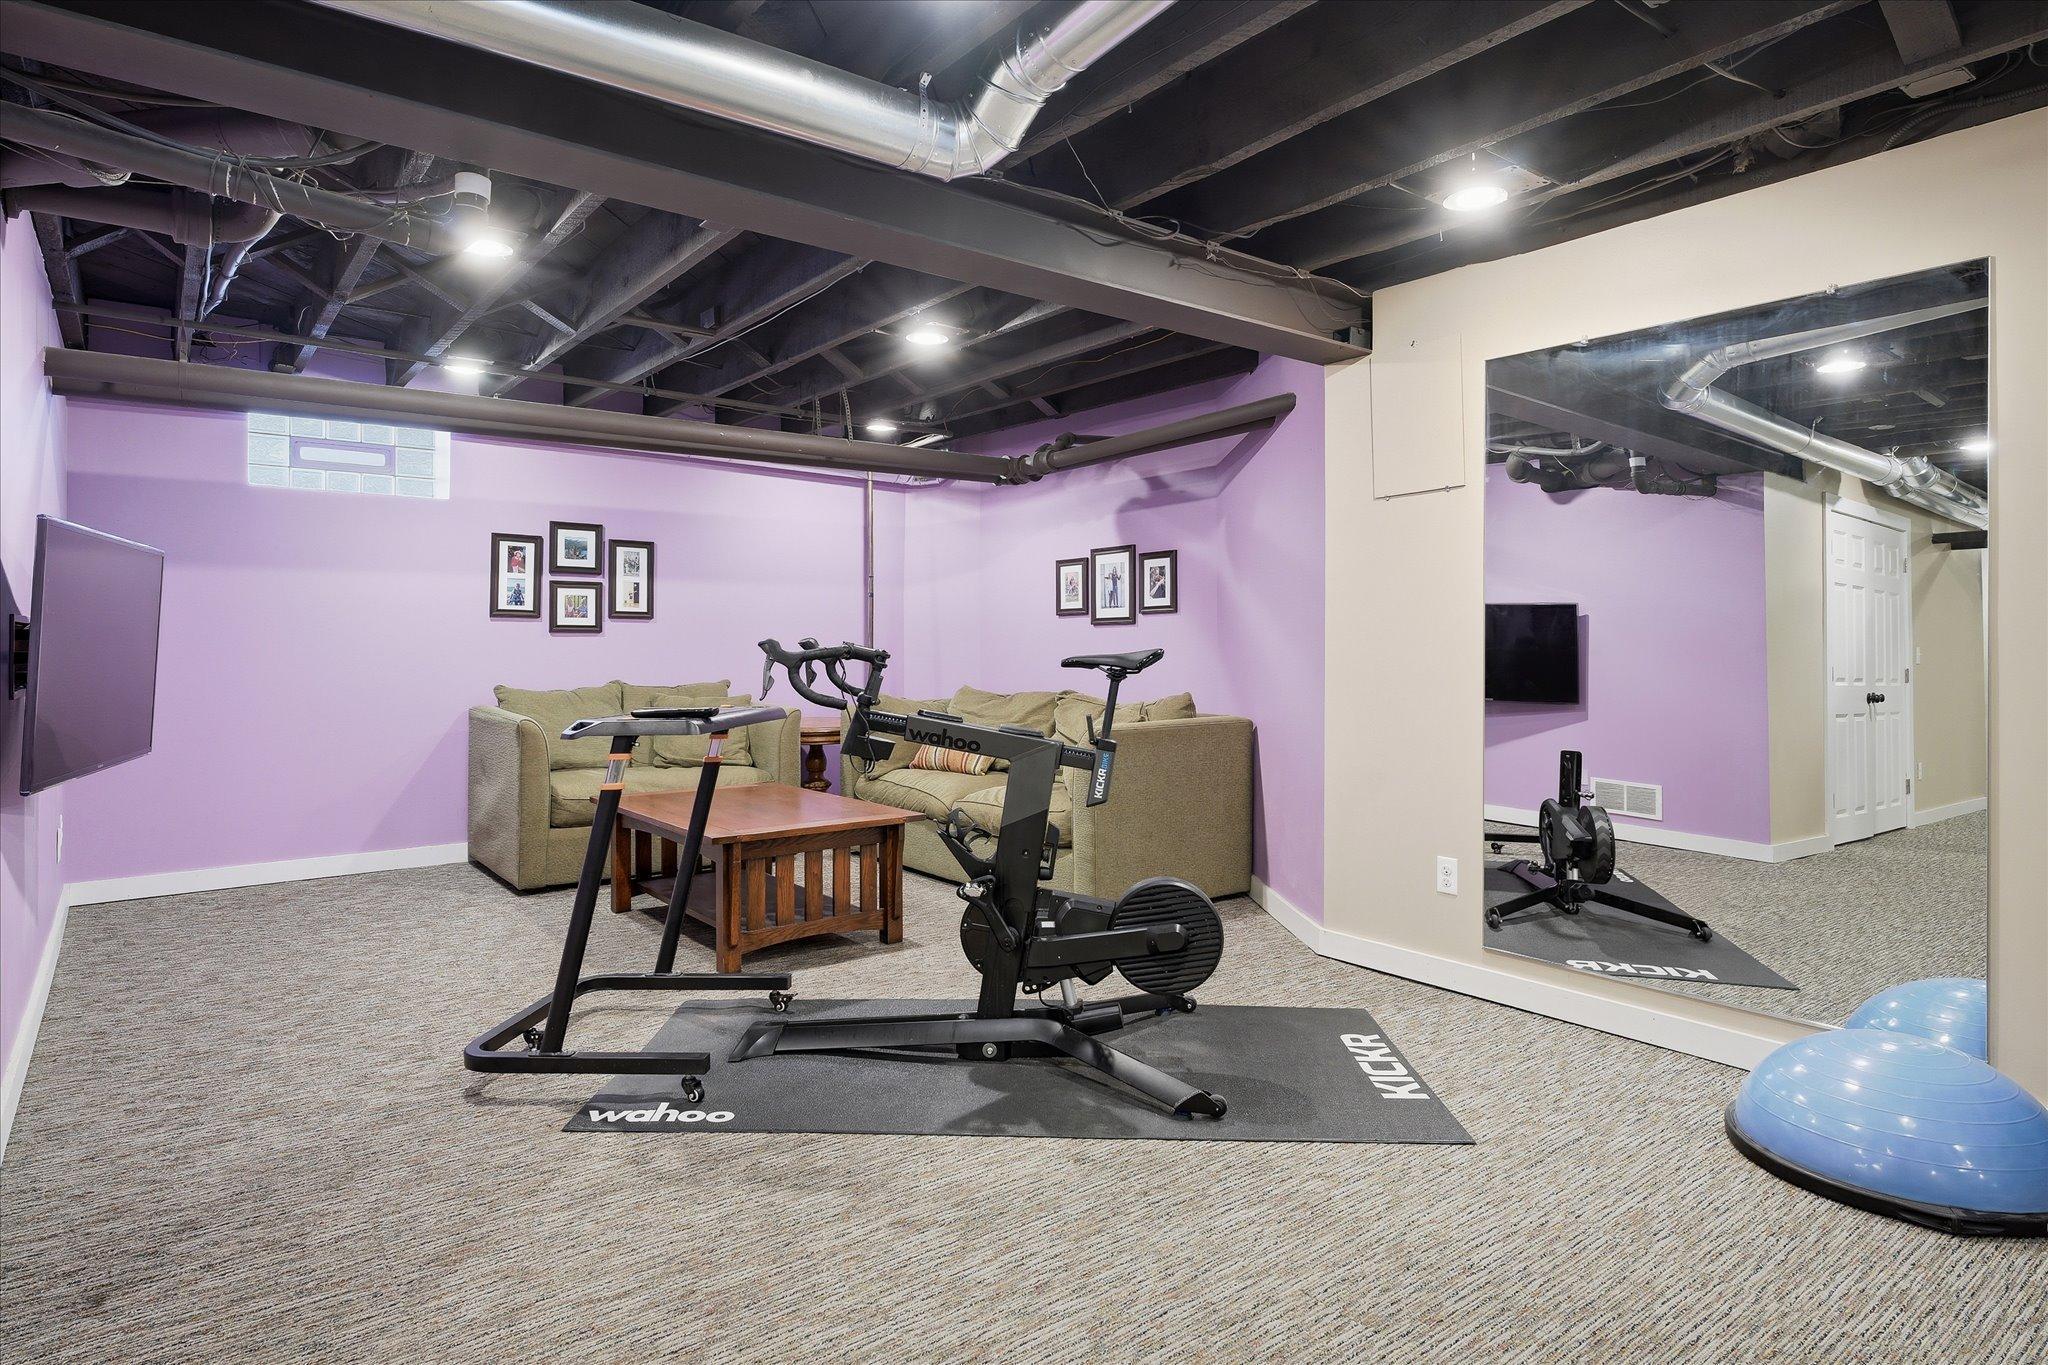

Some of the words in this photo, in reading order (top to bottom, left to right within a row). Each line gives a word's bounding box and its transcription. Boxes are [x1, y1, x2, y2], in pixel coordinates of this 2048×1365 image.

[908, 728, 981, 752] wahoo
[1340, 1033, 1431, 1099] KICKR
[589, 1102, 735, 1123] wahoo
